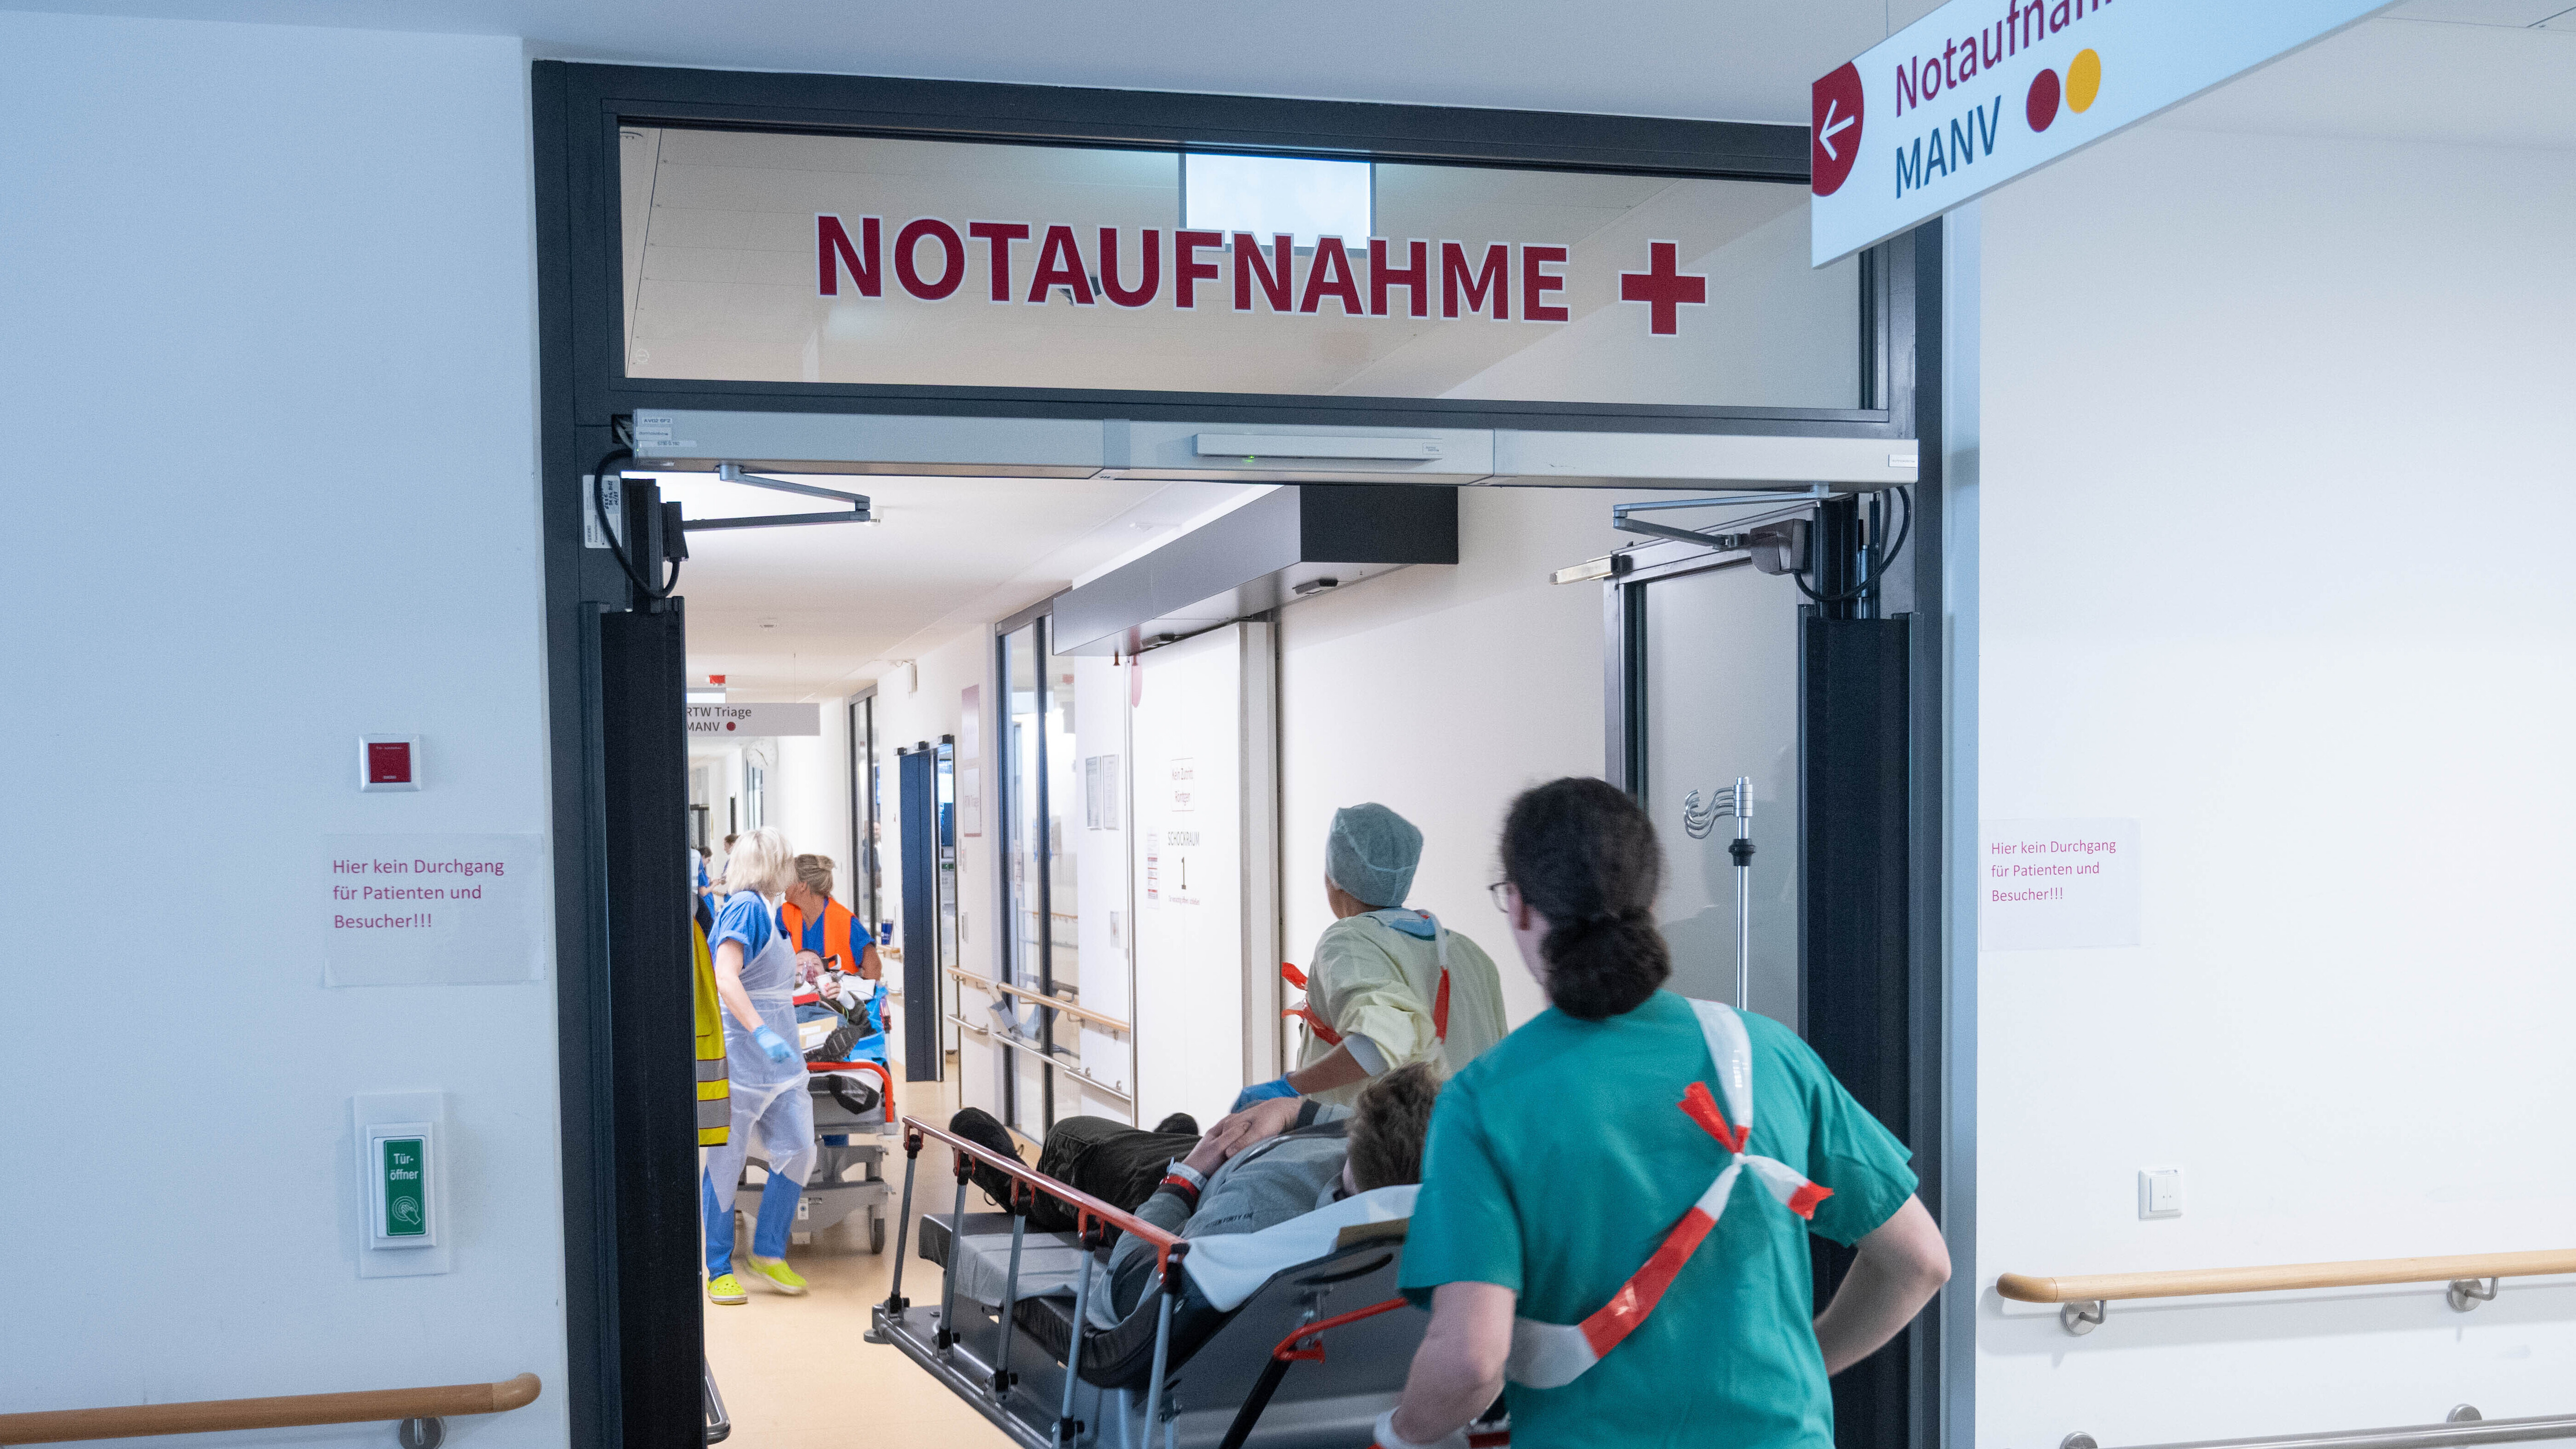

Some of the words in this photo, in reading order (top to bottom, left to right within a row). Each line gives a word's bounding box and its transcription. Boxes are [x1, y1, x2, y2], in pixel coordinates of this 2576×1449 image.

[1896, 0, 2112, 118] Notaufna
[1896, 95, 2001, 199] MANV
[816, 213, 1569, 323] NOTAUFNAHME
[687, 707, 711, 717] RTW
[714, 706, 751, 719] Triage
[687, 722, 720, 731] MANV
[1168, 832, 1199, 846] SCHOCKRAUM
[1992, 842, 2017, 855] Hier
[2021, 841, 2046, 854] kein
[2051, 840, 2116, 855] Durchgang
[333, 860, 368, 874] Hier
[373, 859, 408, 874] kein
[414, 859, 504, 877] Durchgang
[1991, 865, 2009, 877] für
[2013, 864, 2072, 876] Patienten
[2077, 862, 2099, 875] und
[333, 885, 358, 900] für
[363, 886, 444, 900] Patienten
[450, 885, 481, 899] und
[1992, 887, 2062, 902] Besucher!!!
[334, 913, 431, 928] Besucher!!!
[394, 1153, 414, 1165] Tür-
[390, 1169, 418, 1181] öffner
